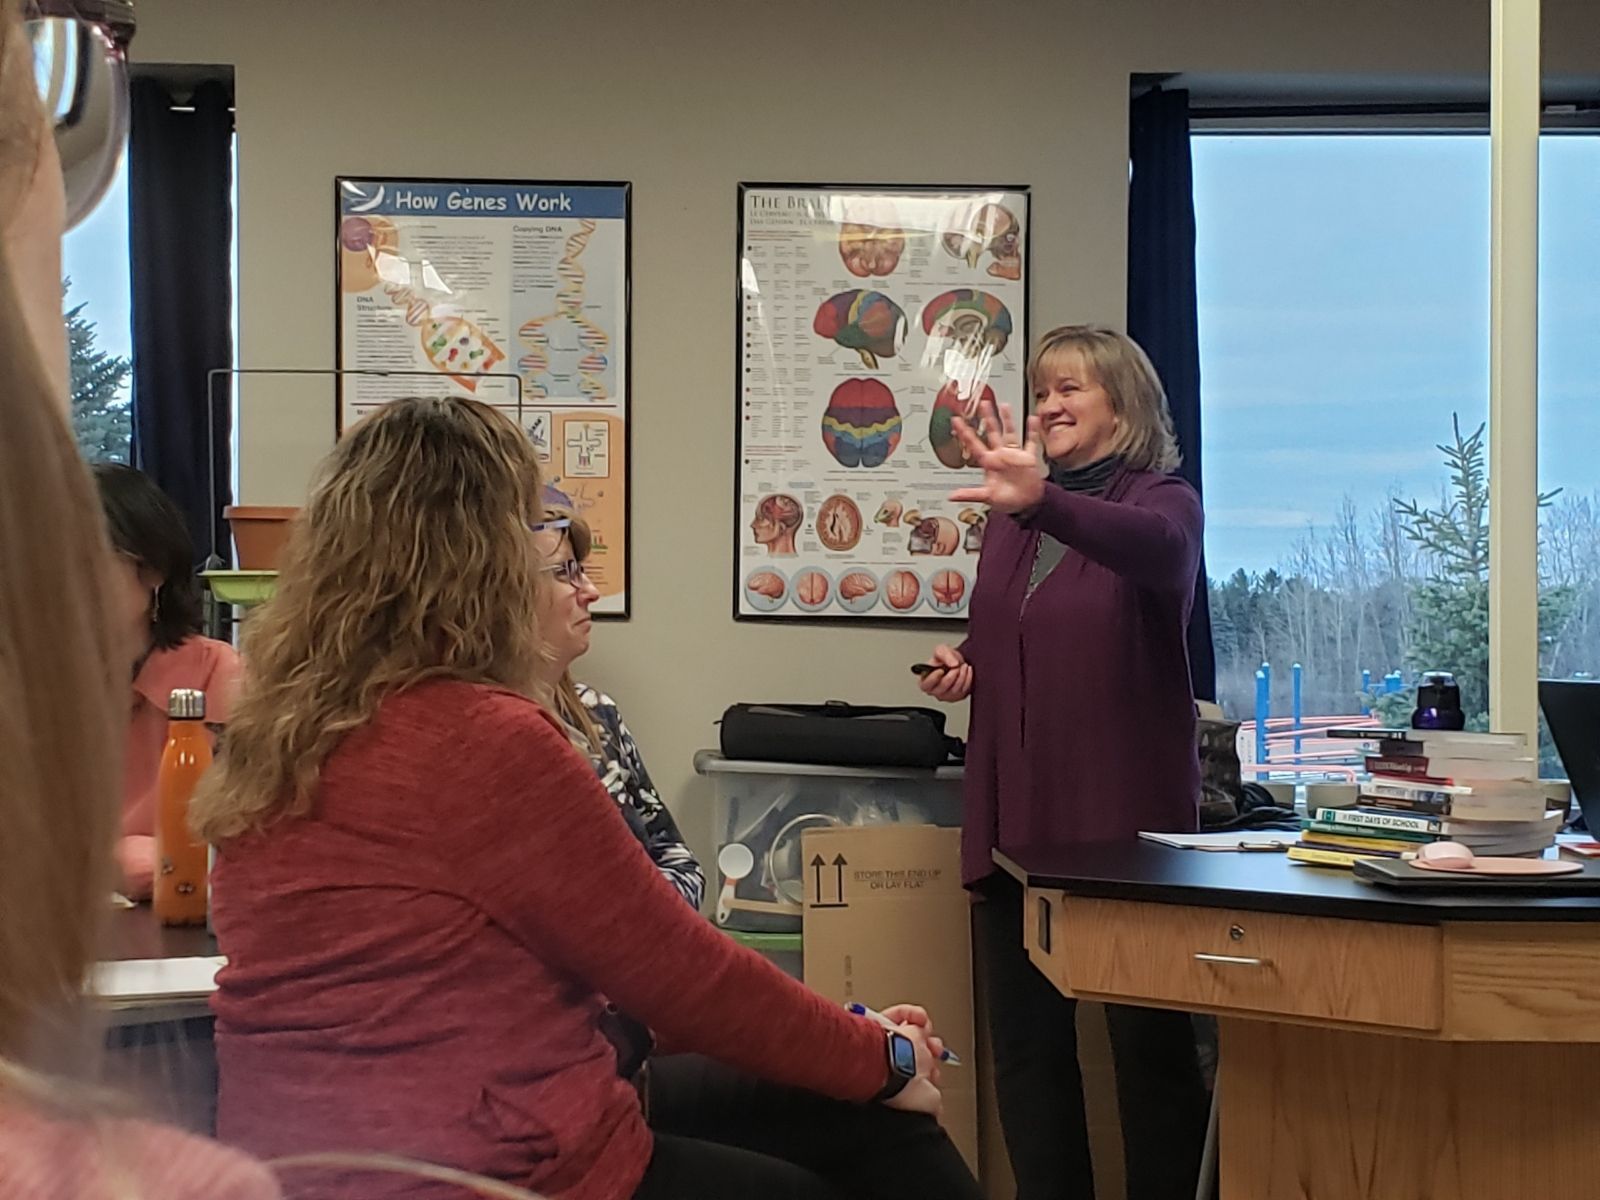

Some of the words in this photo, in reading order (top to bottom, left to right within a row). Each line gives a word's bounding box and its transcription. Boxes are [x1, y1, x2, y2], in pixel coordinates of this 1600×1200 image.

[396, 191, 438, 209] How
[447, 191, 507, 211] Genes
[516, 192, 572, 211] Work
[750, 195, 779, 208] THE
[512, 225, 544, 233] Copying
[1348, 814, 1364, 823] FIRST
[1365, 815, 1381, 825] DAYS
[1382, 818, 1391, 826] OF
[1392, 819, 1420, 829] SCHOOL
[885, 880, 901, 889] LAY
[904, 880, 925, 889] FLAT
